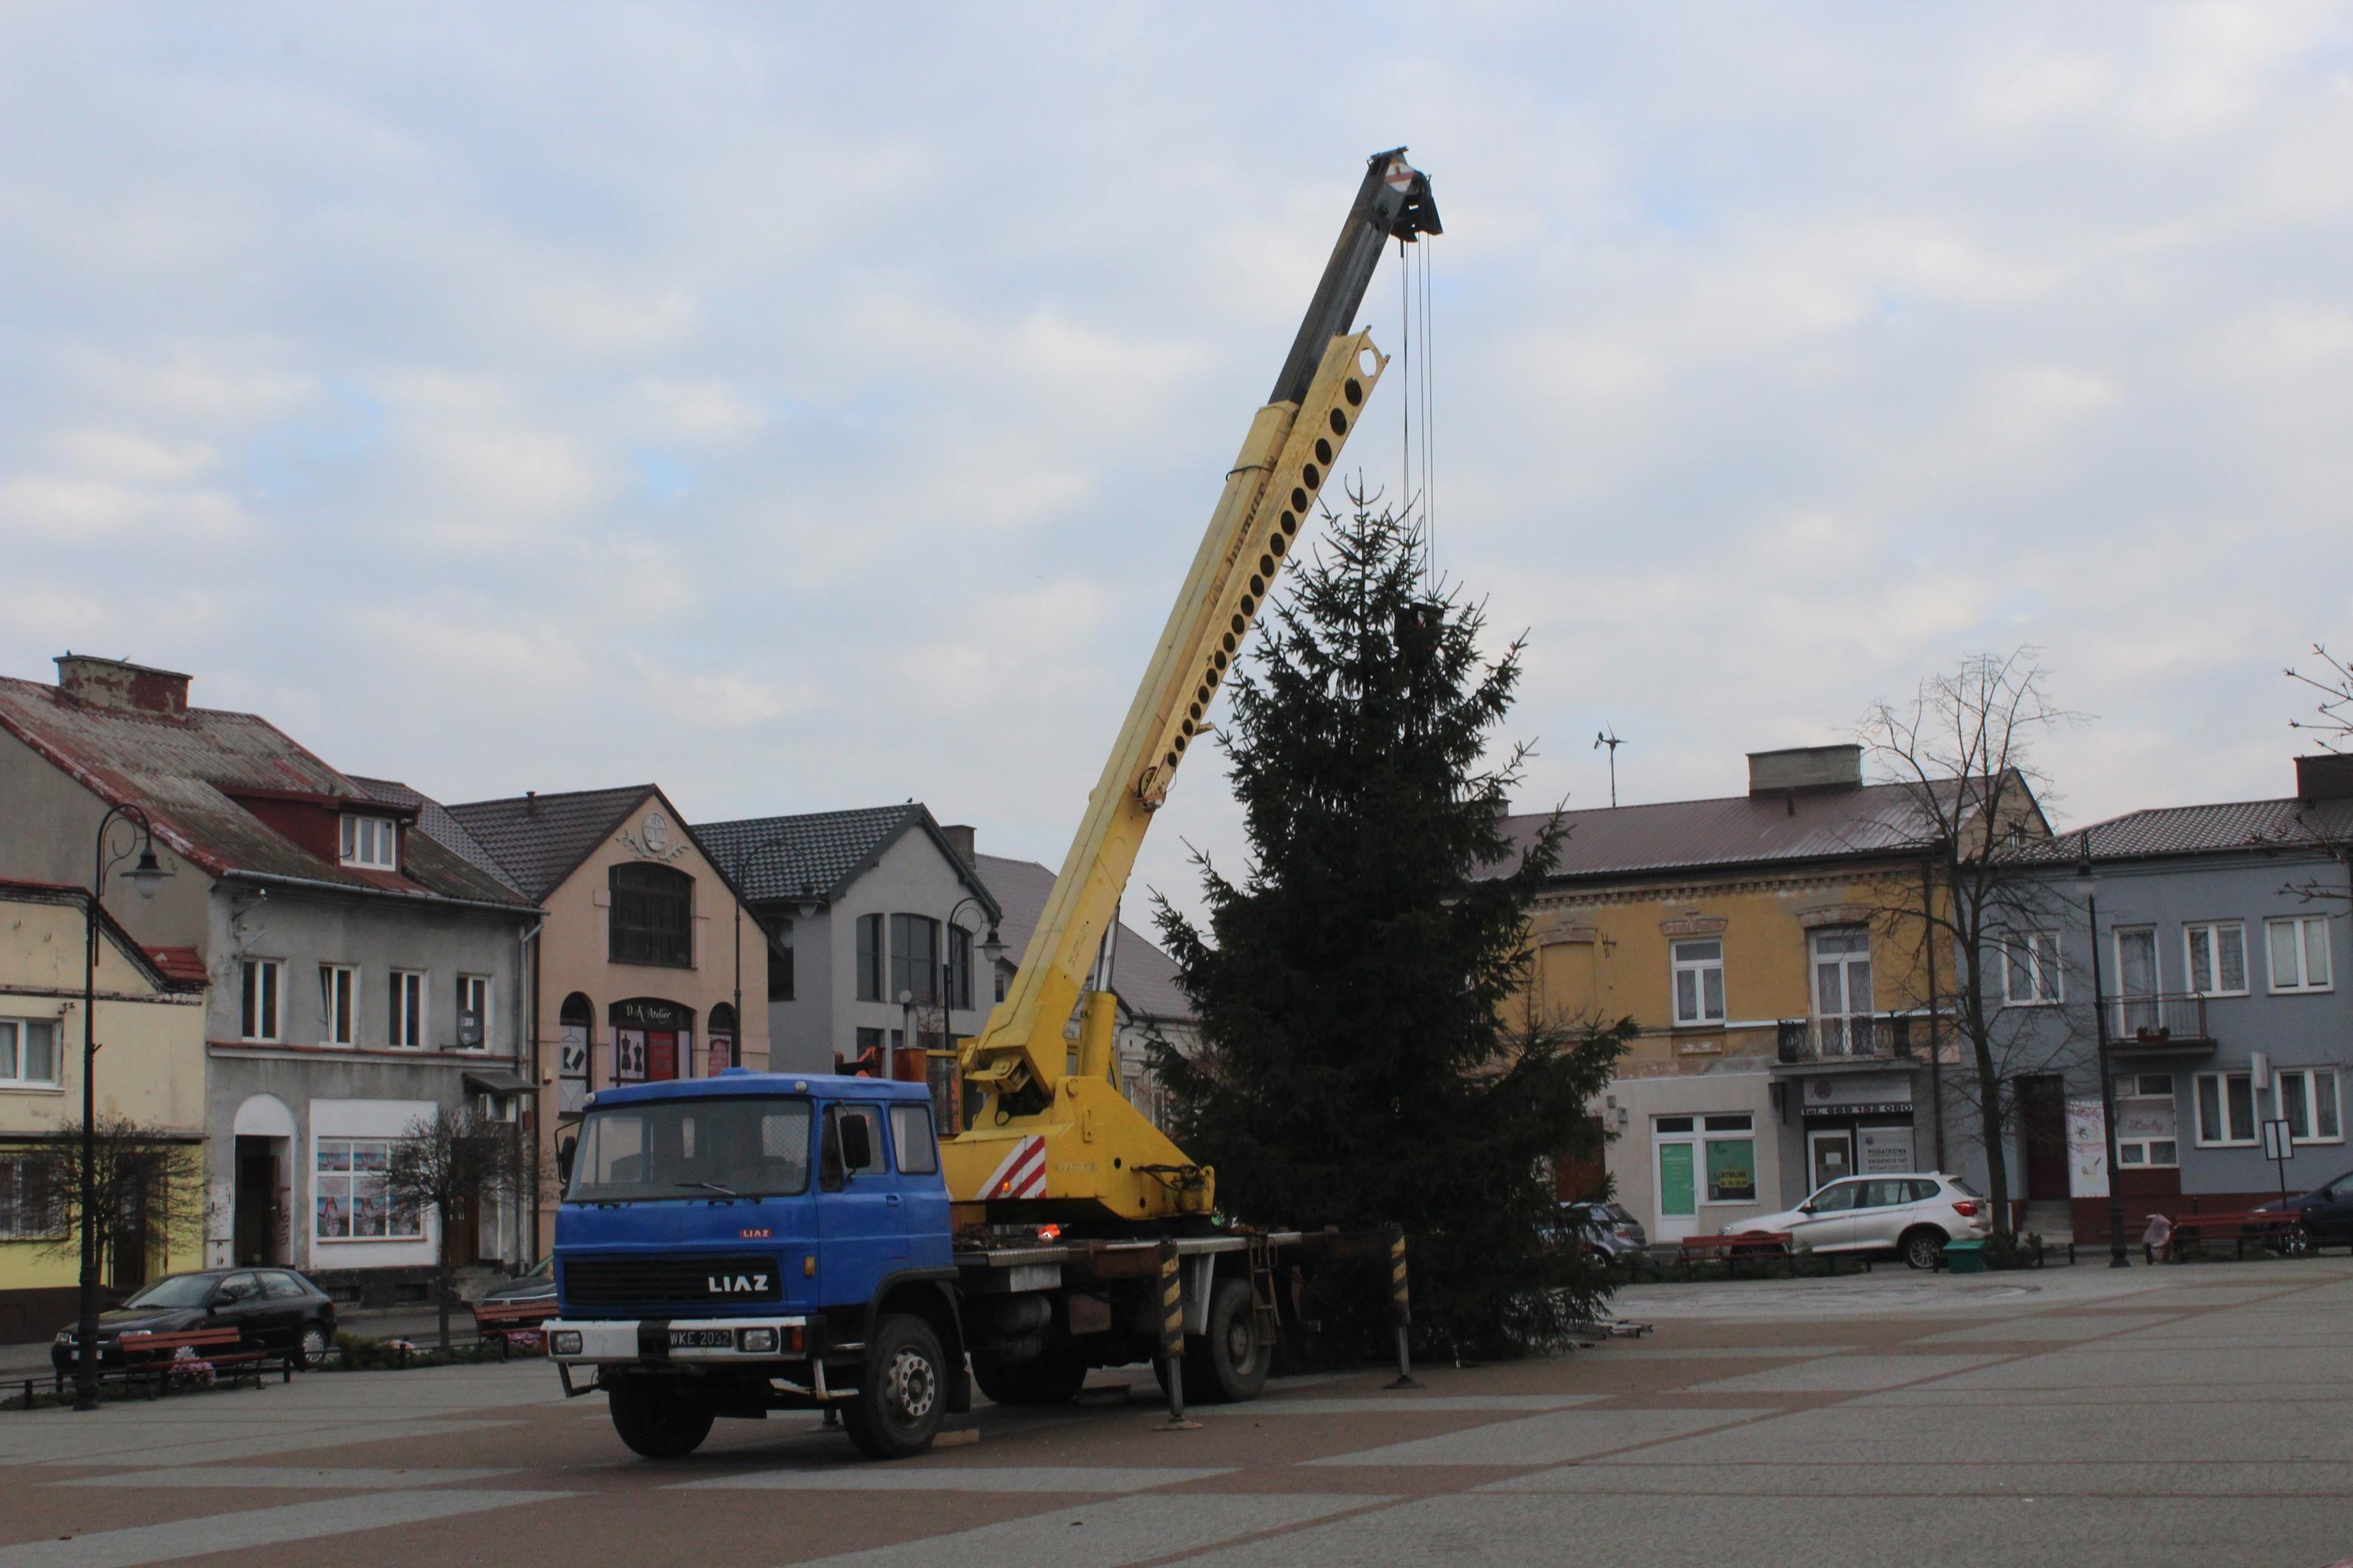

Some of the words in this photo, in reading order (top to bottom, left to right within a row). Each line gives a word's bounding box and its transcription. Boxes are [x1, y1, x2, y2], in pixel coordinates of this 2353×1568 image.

[647, 1007, 672, 1023] Atelier
[2128, 1116, 2165, 1134] Lady
[743, 1229, 769, 1237] LIAZ
[708, 1275, 769, 1293] LIAZ
[670, 1331, 696, 1345] WKE
